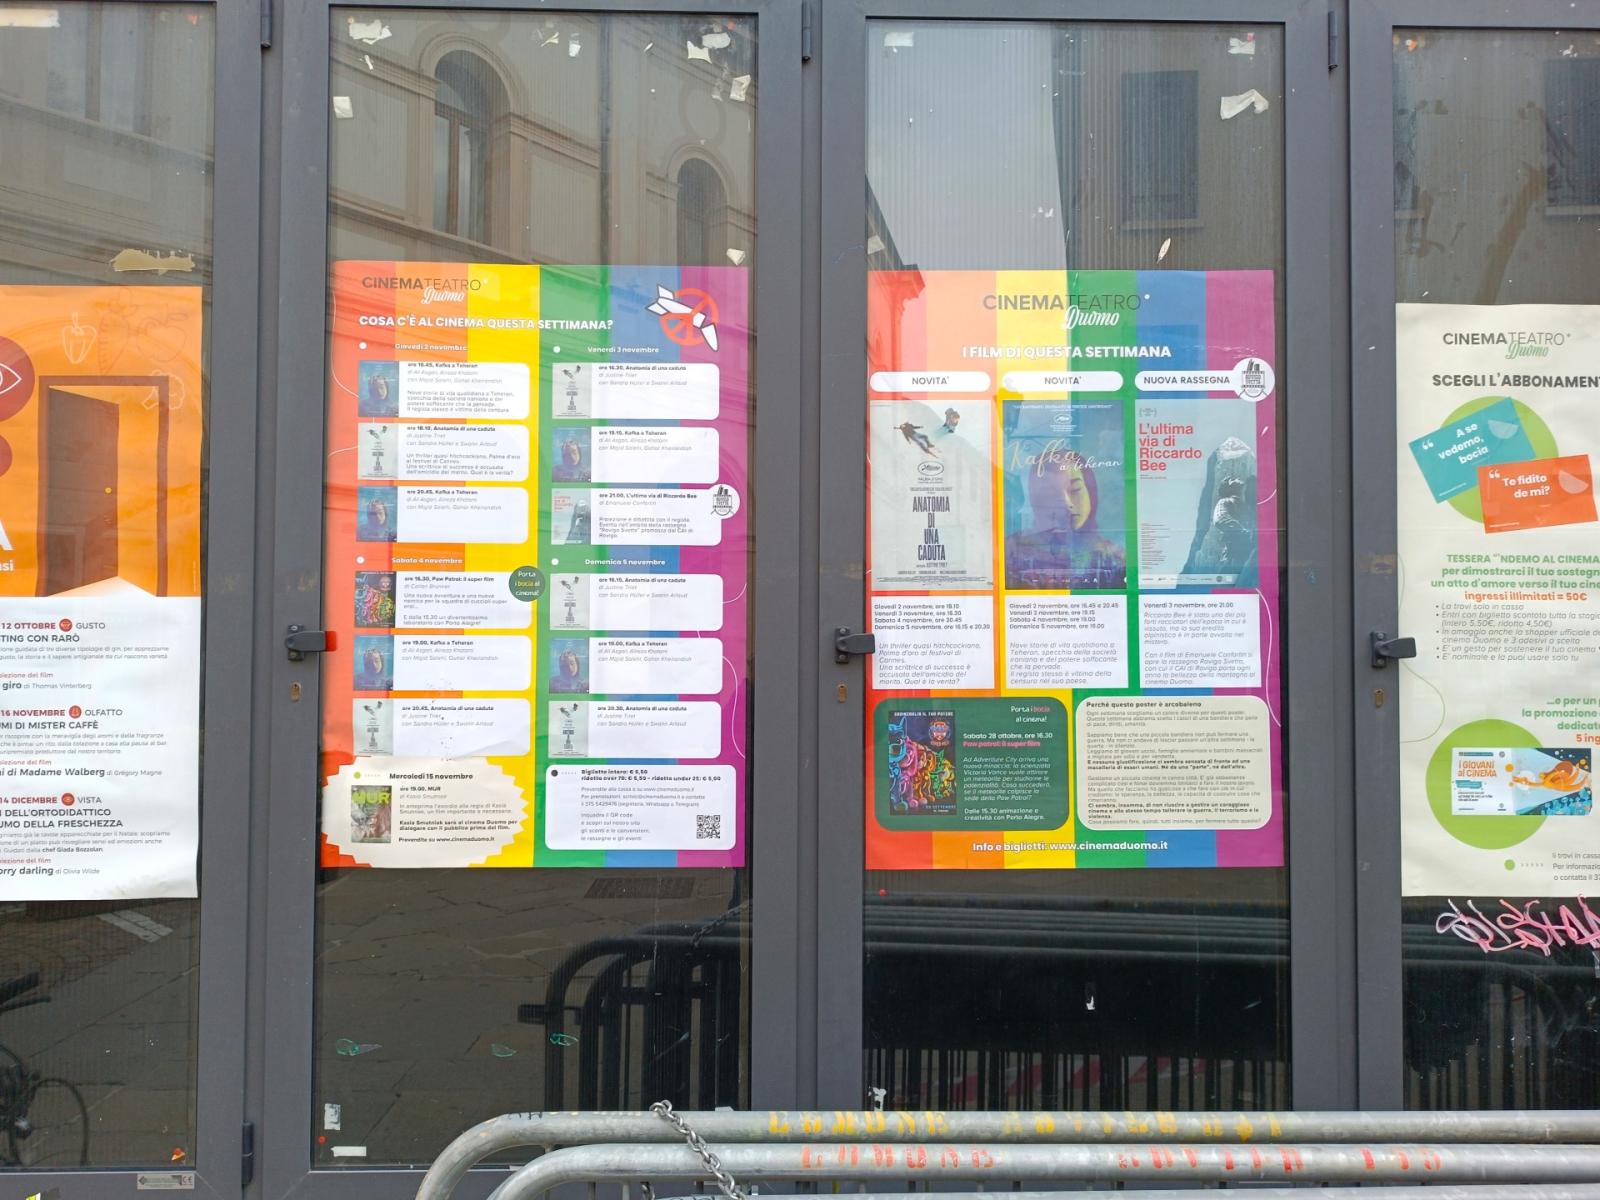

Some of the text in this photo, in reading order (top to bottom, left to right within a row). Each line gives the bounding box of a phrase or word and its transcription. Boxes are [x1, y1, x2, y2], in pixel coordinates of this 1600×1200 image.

[421, 287, 465, 304] Duomo
[359, 314, 613, 330] COSA C'È AL CINEMA QUESTA SETTIMANA?
[1062, 305, 1120, 330] Duomo
[963, 346, 1172, 359] I FILM DI QUESTA SETTIMANA
[1505, 342, 1549, 359] Duomo
[911, 376, 950, 385] NOVITA'
[1044, 375, 1082, 385] NOVITA'
[1144, 376, 1230, 384] NUOVA RASSEGNA
[1432, 373, 1600, 388] SCEGLI L'ABBONAMEN
[1139, 423, 1193, 434] L'ultima
[1456, 423, 1478, 438] A se
[1139, 435, 1175, 446] via di
[1007, 438, 1077, 478] Kafka
[1140, 447, 1202, 459] Riccardo
[1459, 445, 1489, 465] bocia
[1140, 460, 1167, 471] Bee
[1503, 473, 1547, 487] Te fidito
[1514, 485, 1550, 499] de mi?
[913, 496, 950, 512] ANATOMIA
[928, 513, 935, 528] DI
[924, 529, 939, 544] UNA
[918, 545, 945, 560] CADUTA
[1447, 555, 1491, 563] TESSERA
[1543, 555, 1555, 563] AL
[1442, 568, 1460, 577] per
[1462, 567, 1526, 576] dimostrarci
[1528, 567, 1534, 576] il
[1536, 568, 1555, 576] tuo
[1447, 580, 1469, 588] atto
[1471, 579, 1516, 588] d'amore
[1550, 580, 1557, 588] il
[1559, 580, 1577, 588] tuo
[1465, 591, 1508, 602] ingressi
[1509, 592, 1555, 600] illimitati
[1566, 592, 1587, 601] 50€
[51, 634, 80, 642] RARÒ
[2, 681, 22, 690] giro
[1563, 698, 1581, 707] per
[1522, 708, 1597, 720] la promozione
[68, 720, 99, 729] CAFFÈ
[1557, 721, 1600, 730] dedicat
[1576, 734, 1583, 742] 5
[7, 768, 17, 776] di
[20, 768, 62, 776] Madame
[65, 768, 105, 777] Walberg
[140, 769, 162, 777] Magne
[389, 772, 425, 780] Mercoledì
[5, 809, 111, 817] DELL'ORTODIDATTICO
[58, 820, 123, 828] FRESCHEZZA
[973, 843, 993, 851] Info
[1050, 841, 1168, 850] www.cinemaduomo.it
[19, 866, 54, 876] darling
